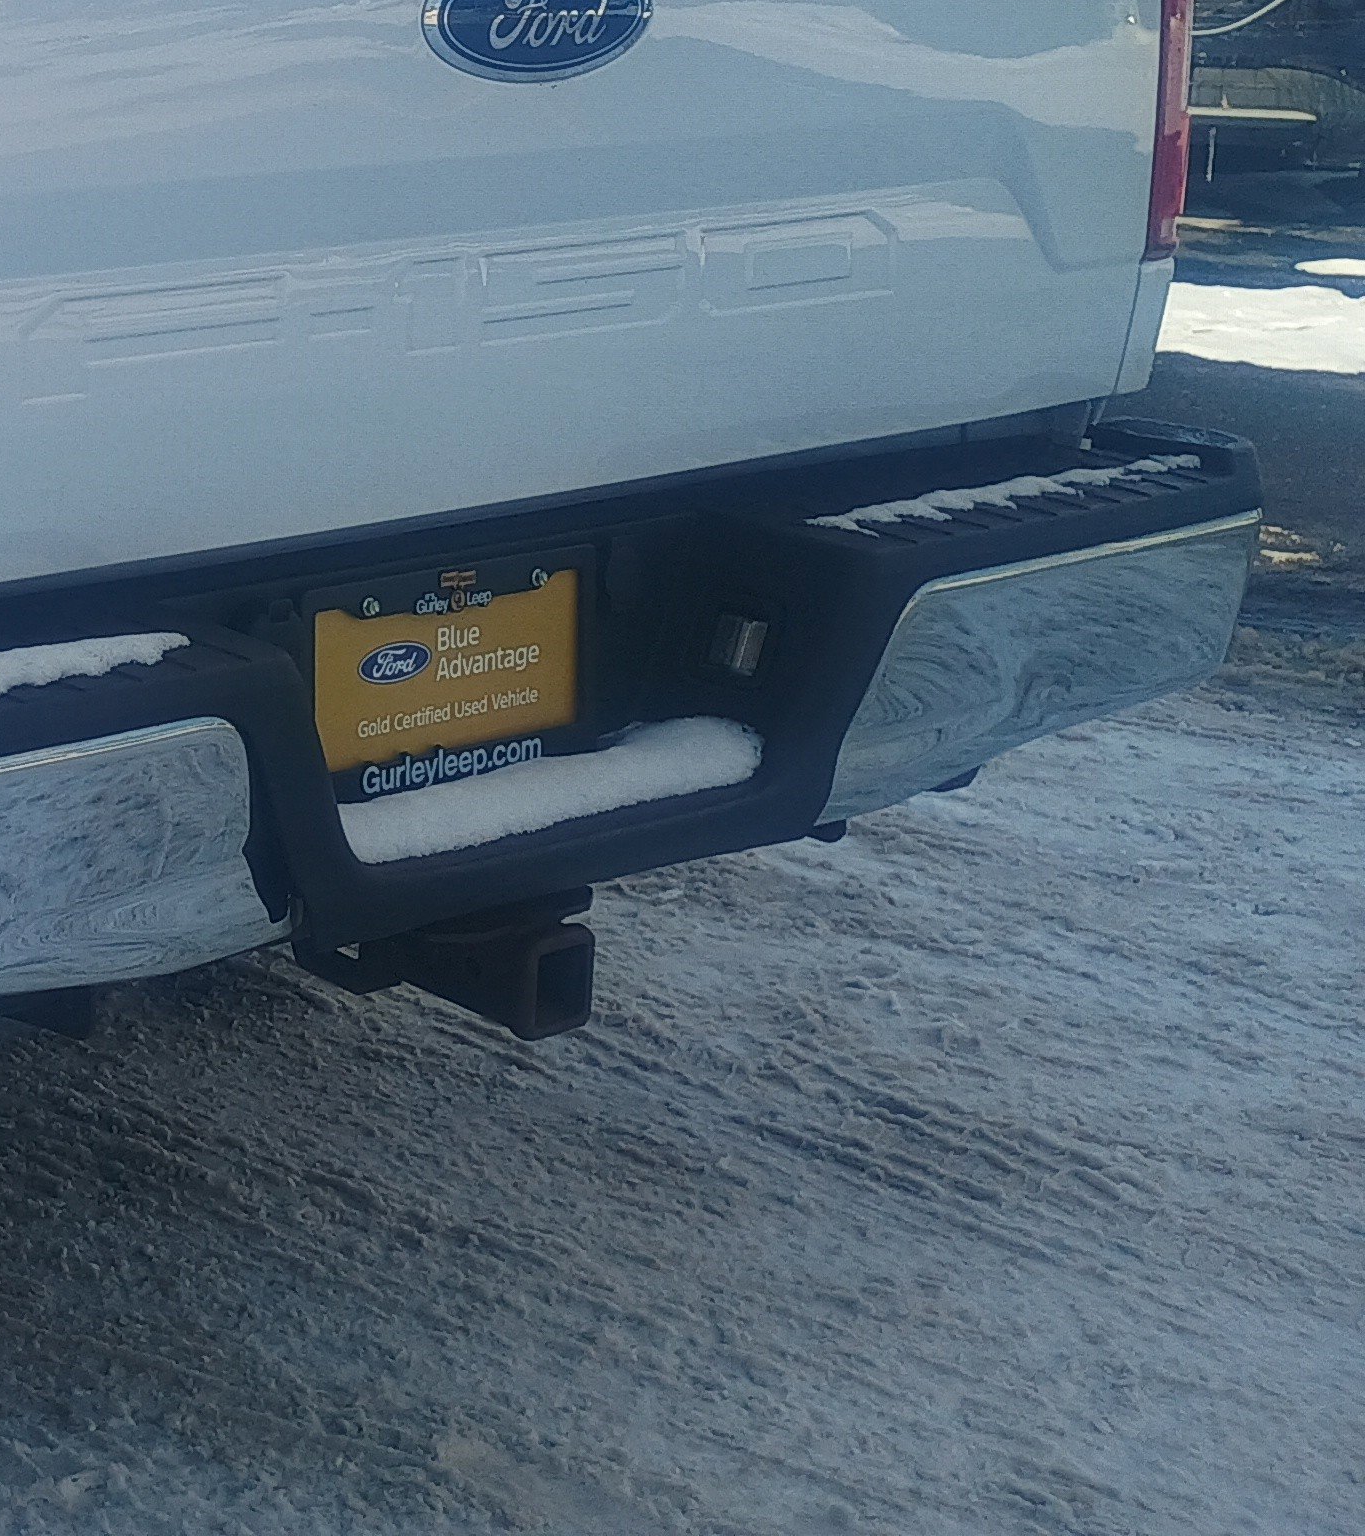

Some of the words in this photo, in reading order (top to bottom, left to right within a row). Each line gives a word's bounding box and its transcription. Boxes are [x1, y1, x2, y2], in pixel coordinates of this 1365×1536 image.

[416, 596, 450, 615] Gurley
[466, 590, 493, 607] Leep
[437, 625, 480, 652] Blue
[372, 648, 417, 678] Ford
[435, 644, 540, 681] Advantage
[358, 715, 390, 738] Gold
[394, 704, 451, 730] Certified
[454, 697, 488, 718] Used
[491, 687, 539, 710] Vehicle
[362, 737, 543, 794] Gurleyleep.com
